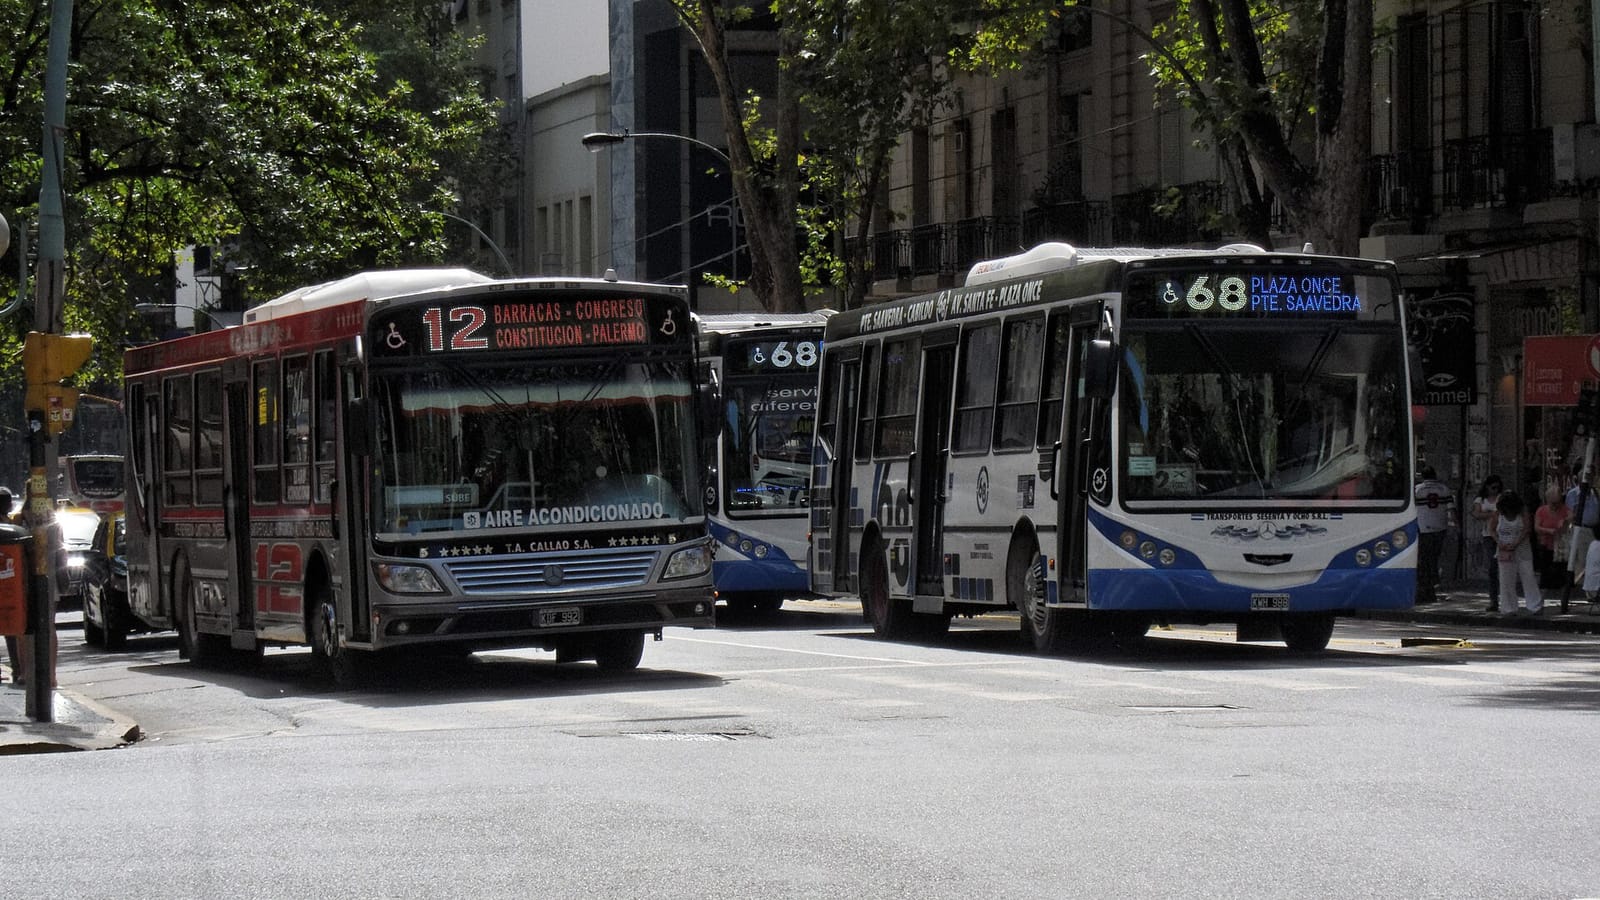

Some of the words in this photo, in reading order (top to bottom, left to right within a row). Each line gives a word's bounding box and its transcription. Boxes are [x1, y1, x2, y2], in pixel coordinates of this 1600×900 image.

[964, 290, 986, 311] SANTA
[985, 288, 996, 309] FE
[999, 284, 1021, 307] PLAZA
[1022, 280, 1043, 303] ONCE
[1186, 276, 1247, 311] 68
[1251, 277, 1298, 294] PLAZA
[1301, 277, 1341, 294] ONCE
[494, 302, 561, 323] BARRACAS
[575, 299, 643, 320] CONGRESO
[873, 306, 904, 330] SAAVEDRA
[907, 300, 934, 323] CABILDO
[1251, 295, 1283, 311] PTE.
[1286, 295, 1361, 311] SAAVEDRA
[422, 306, 489, 351] 12
[496, 326, 583, 348] CONSTITUCION
[593, 322, 645, 343] PALERMO
[771, 341, 818, 367] 68
[445, 493, 471, 503] SUBE
[484, 510, 523, 528] AIRE
[527, 502, 664, 526] ACONDICIONADO
[1206, 513, 1253, 521] TRANSPORTES
[1257, 513, 1285, 521] SESENTA
[1292, 512, 1310, 520] OCHO
[505, 543, 525, 553] T.A.
[530, 540, 570, 552] CALLAO
[574, 539, 594, 550] S.A.
[255, 542, 303, 614] 12
